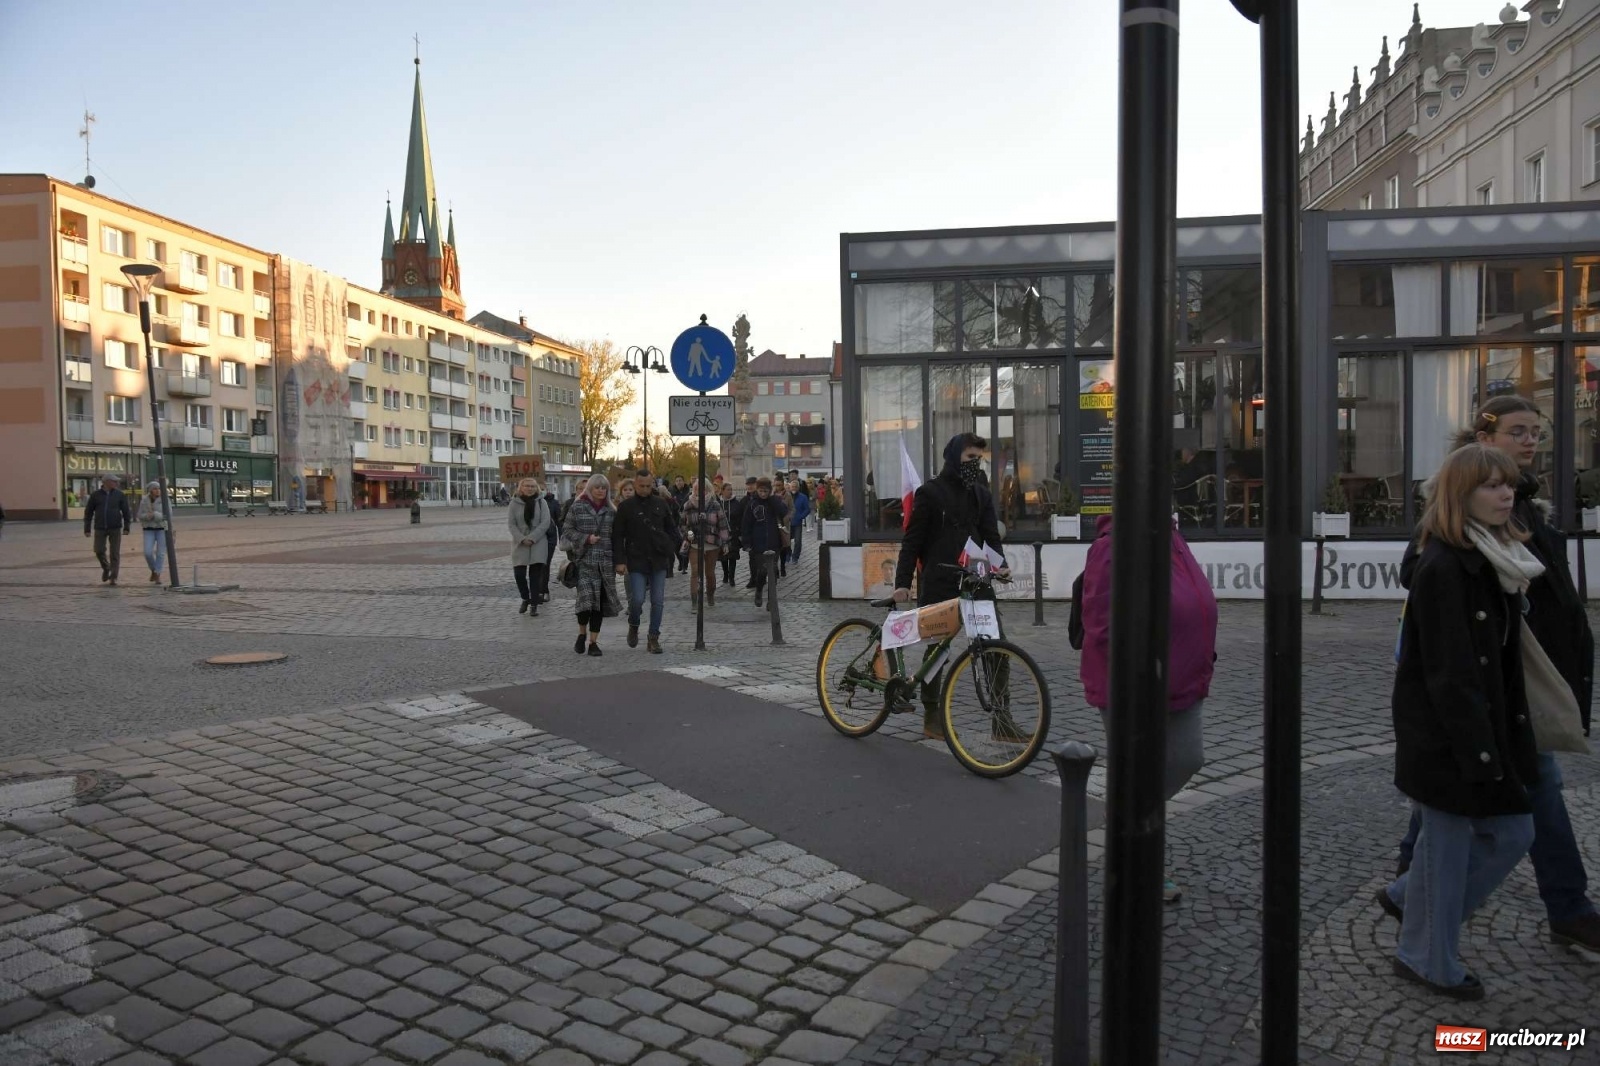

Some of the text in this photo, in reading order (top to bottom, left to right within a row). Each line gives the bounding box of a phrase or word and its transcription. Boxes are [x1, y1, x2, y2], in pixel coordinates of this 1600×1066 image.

[673, 399, 732, 409] Nie dotyczy
[68, 453, 124, 471] STELLA
[195, 459, 238, 469] JUBILER
[505, 460, 540, 474] STOP
[1314, 546, 1404, 590] Brow
